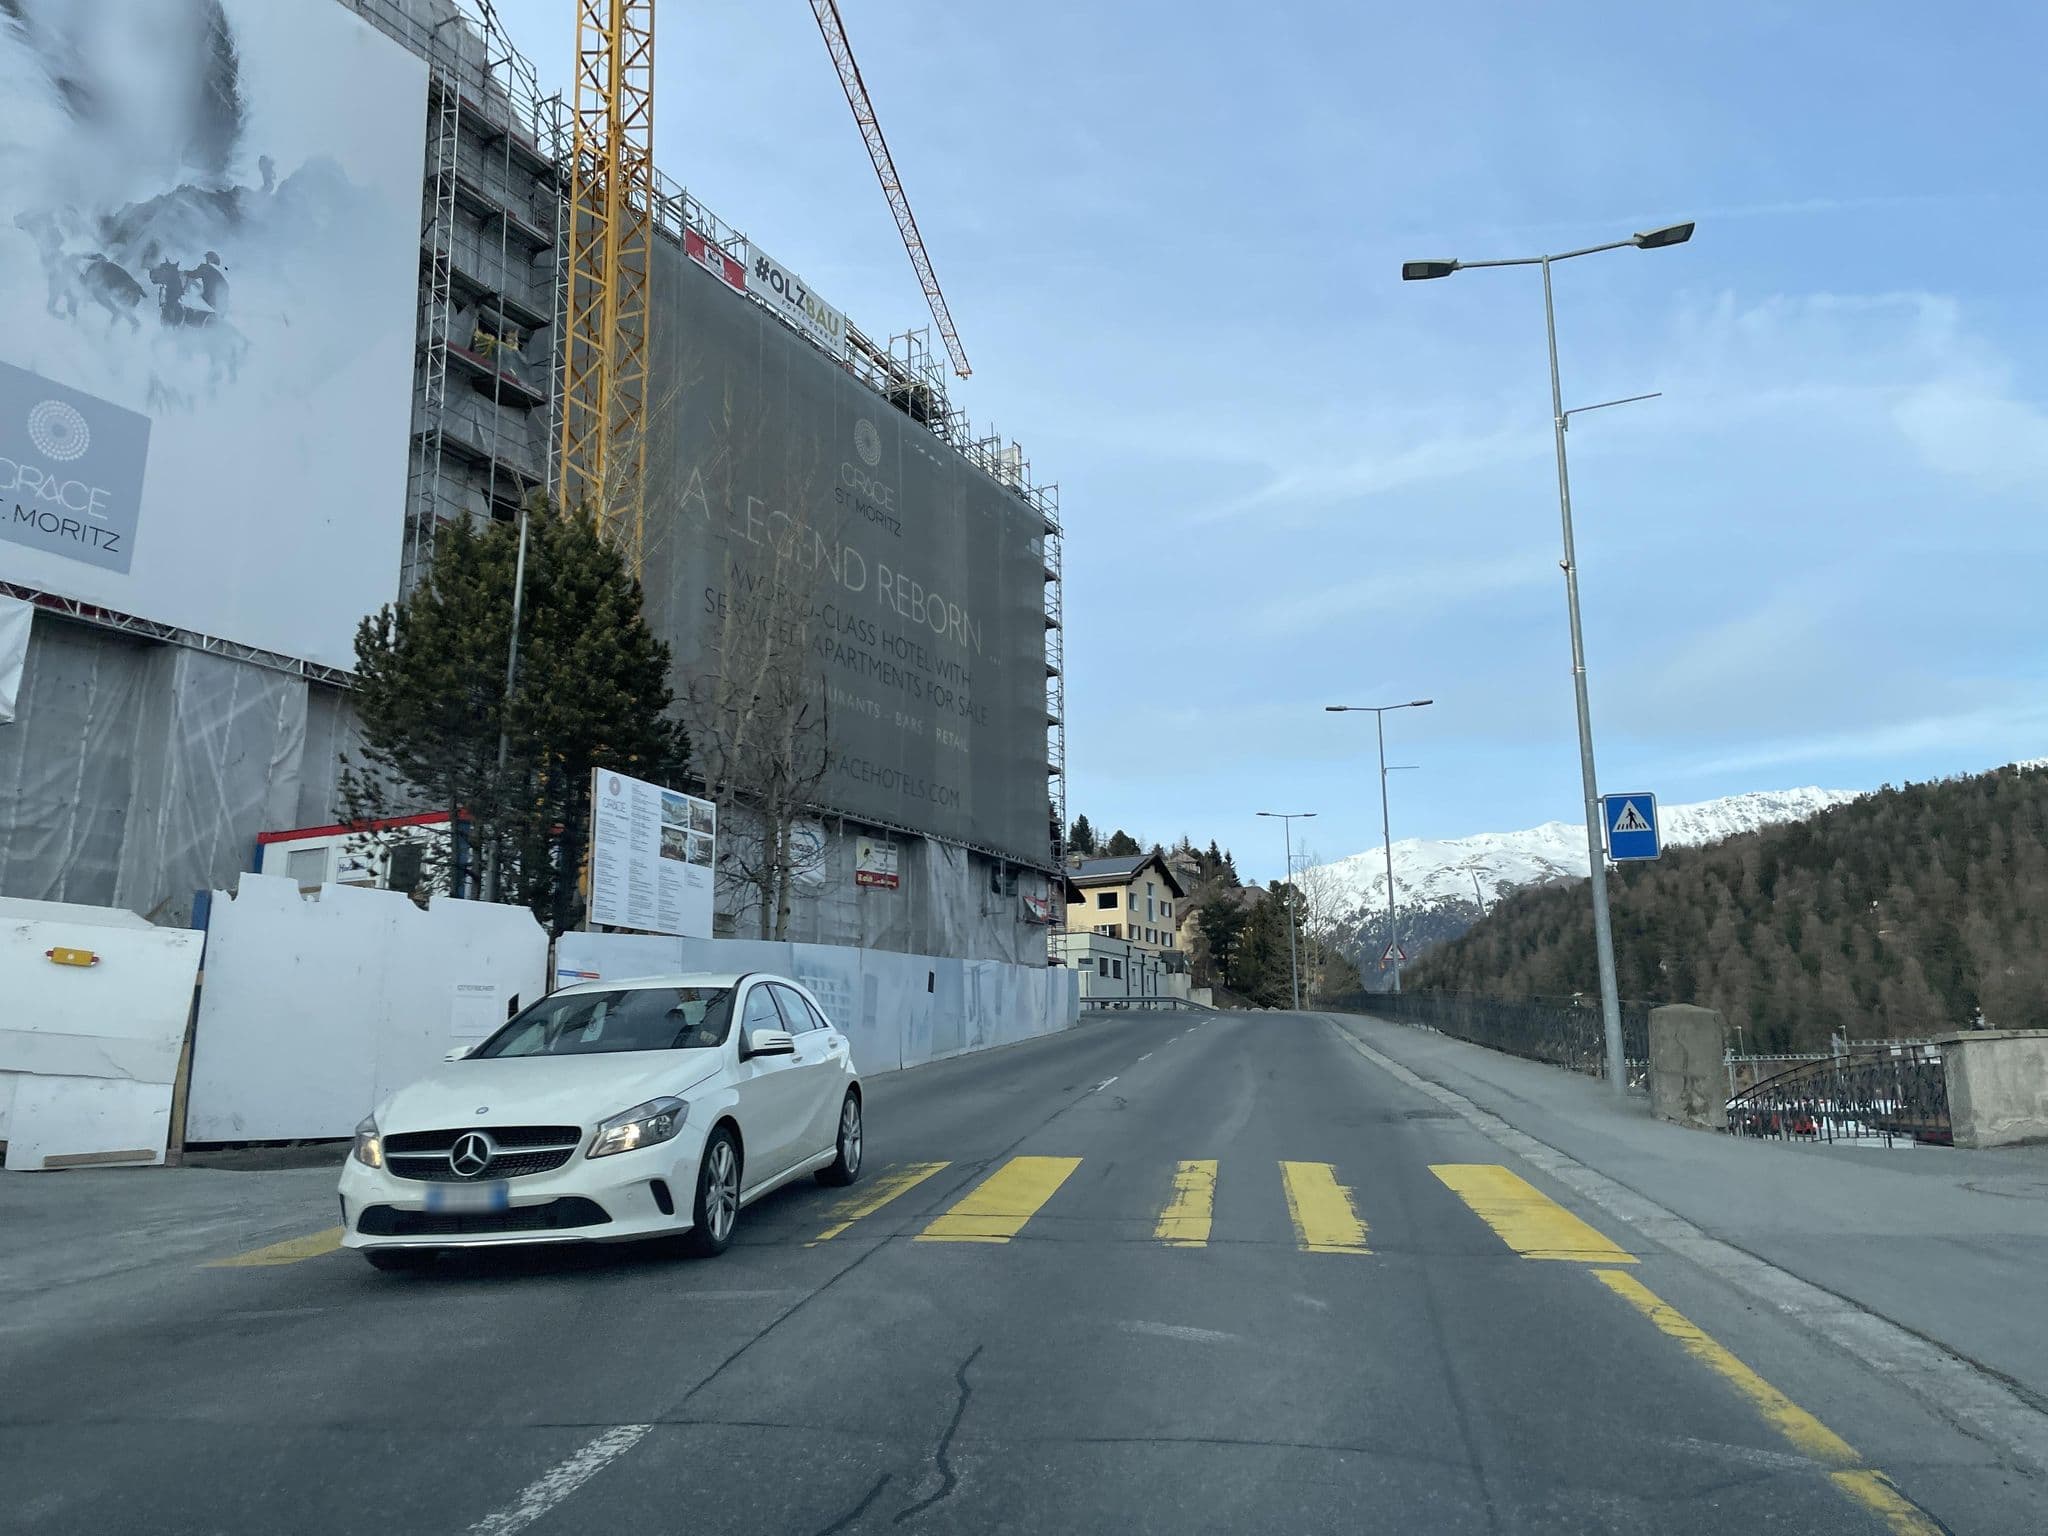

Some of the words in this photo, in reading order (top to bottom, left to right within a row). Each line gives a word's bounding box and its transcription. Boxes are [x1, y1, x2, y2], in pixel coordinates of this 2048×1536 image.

[755, 256, 839, 337] #OLZBAU
[841, 462, 895, 512] GRACE
[13, 503, 121, 553] MORITZ
[855, 498, 902, 537] MORITZ
[681, 466, 711, 521] A
[728, 490, 867, 592] EGEND
[878, 563, 983, 656] REBORN
[813, 634, 921, 698] APARTMENTS
[927, 681, 954, 710] FOR
[958, 695, 988, 727] SALE
[882, 630, 932, 673] HOTEL
[934, 655, 973, 688] WITH
